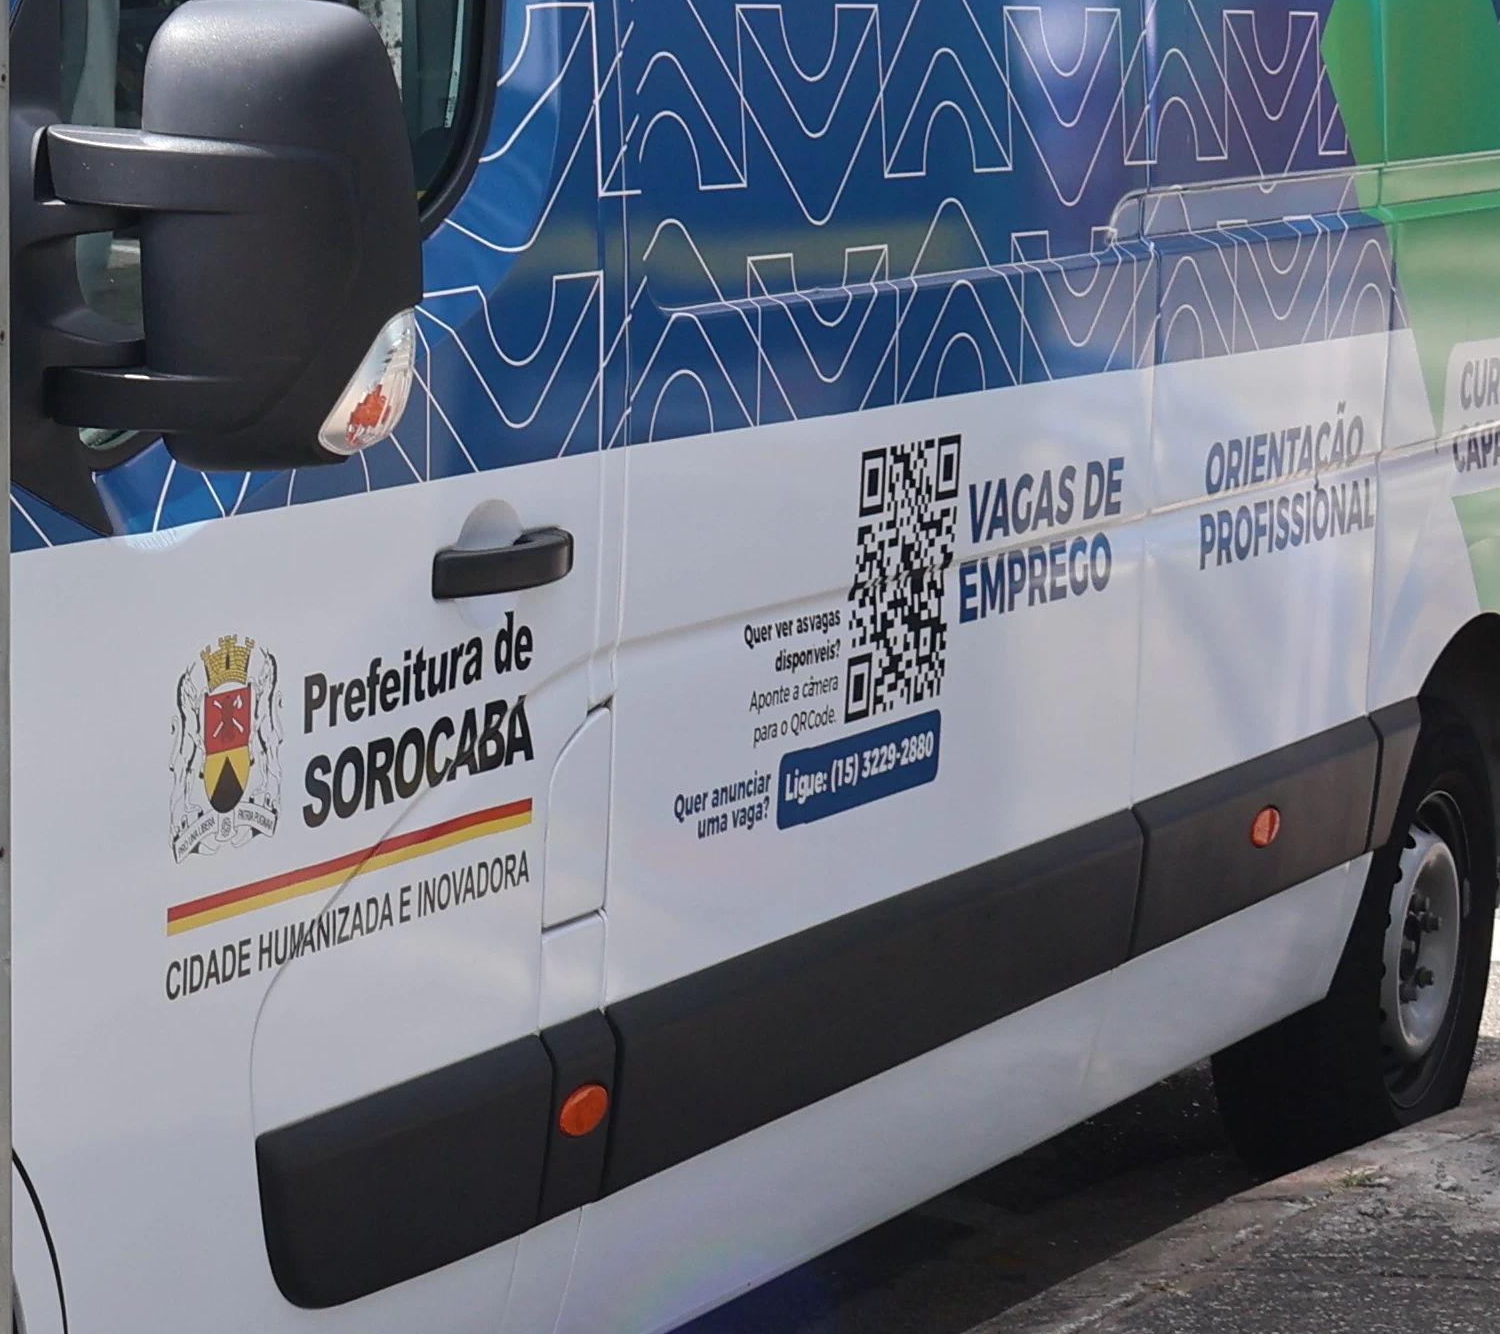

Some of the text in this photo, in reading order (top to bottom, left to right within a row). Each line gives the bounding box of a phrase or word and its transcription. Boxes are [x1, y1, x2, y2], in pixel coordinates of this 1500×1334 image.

[1205, 400, 1364, 495] ORIENTAÇÃO
[969, 457, 1124, 544] VAGAS DE
[1199, 478, 1375, 571] PROFISSIONAL
[959, 532, 1112, 624] EMPREGO
[304, 610, 533, 734] Prefeitura de
[744, 625, 772, 648] Quer
[775, 622, 793, 639] ver
[750, 674, 838, 715] Aponte a câmera
[753, 720, 778, 747] para
[780, 719, 788, 735] o
[302, 695, 534, 829] SOROCABA
[674, 770, 772, 823] Quer anunciar
[785, 730, 934, 804] Ligue: (15) 3229-2880
[697, 796, 770, 839] uma vaga?
[165, 850, 530, 1001] CIDADE HUMANIZADA E INOVADORA
